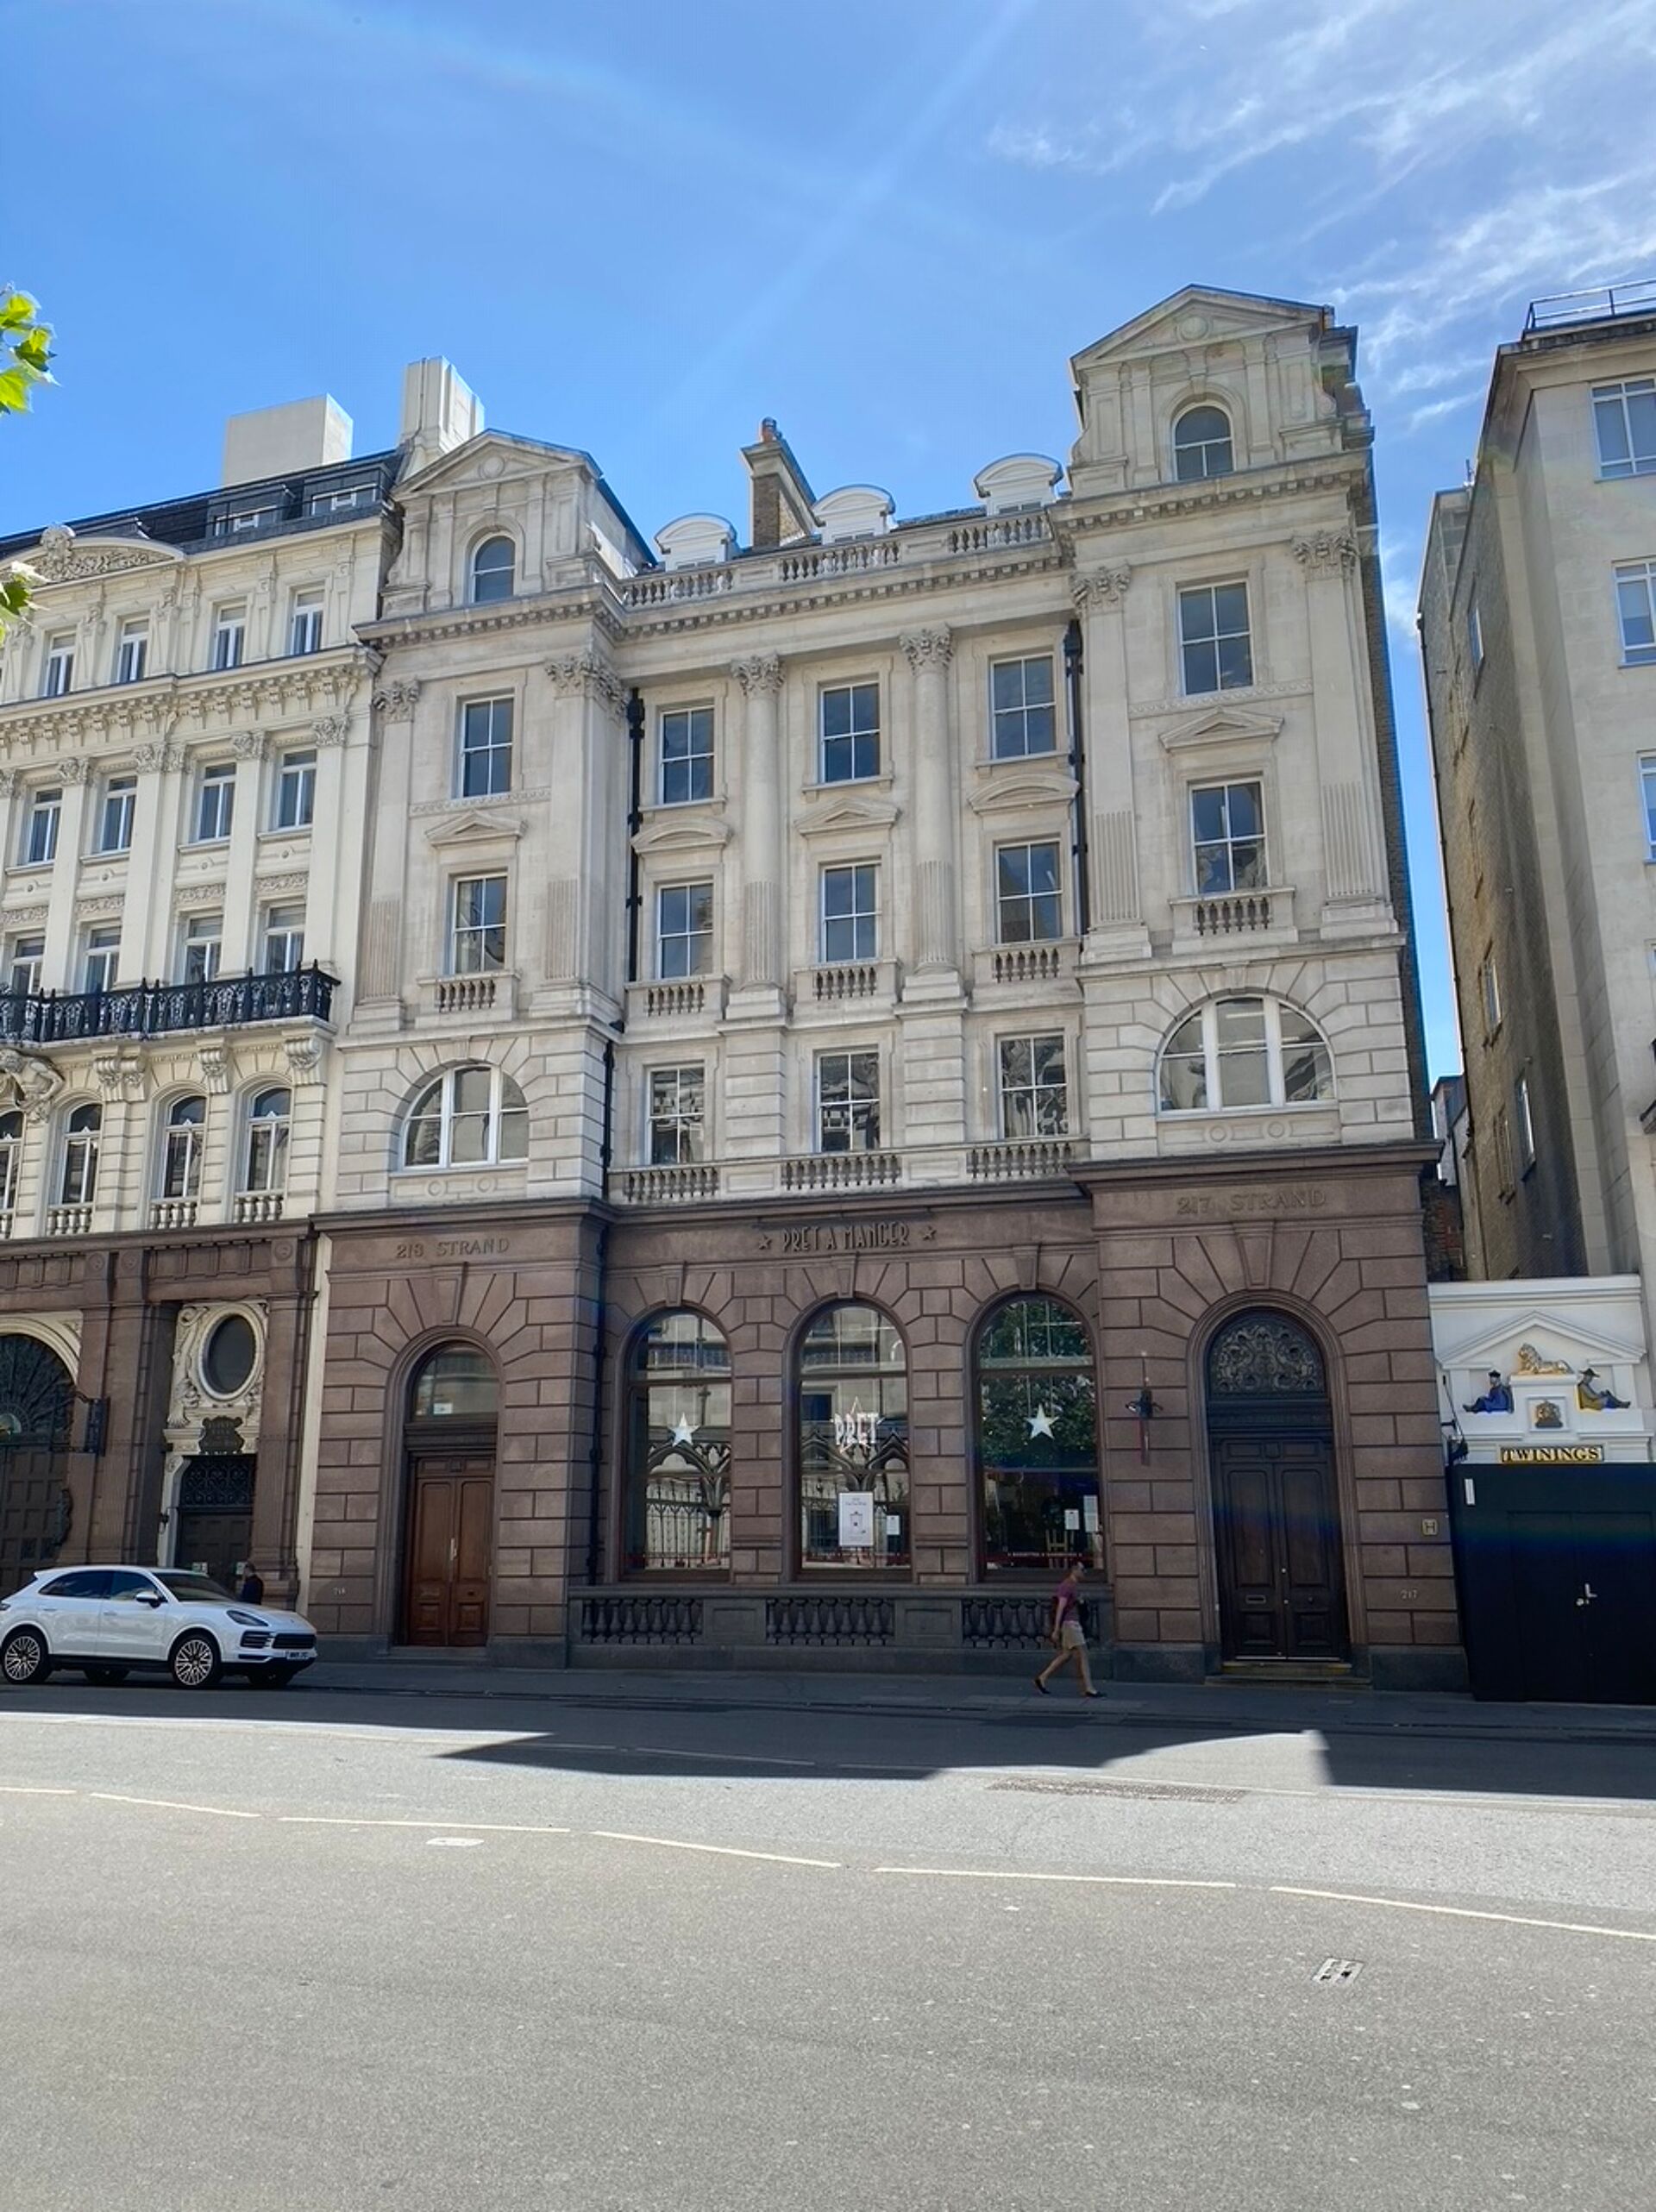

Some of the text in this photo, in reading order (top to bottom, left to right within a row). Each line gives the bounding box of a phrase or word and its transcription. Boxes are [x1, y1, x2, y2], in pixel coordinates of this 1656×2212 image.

[1229, 1189, 1327, 1212] STRAND
[436, 1238, 510, 1256] STRAND
[781, 1220, 910, 1252] PRET A MANGER
[834, 1412, 880, 1446] PRET
[1502, 1446, 1600, 1463] TWININGS
